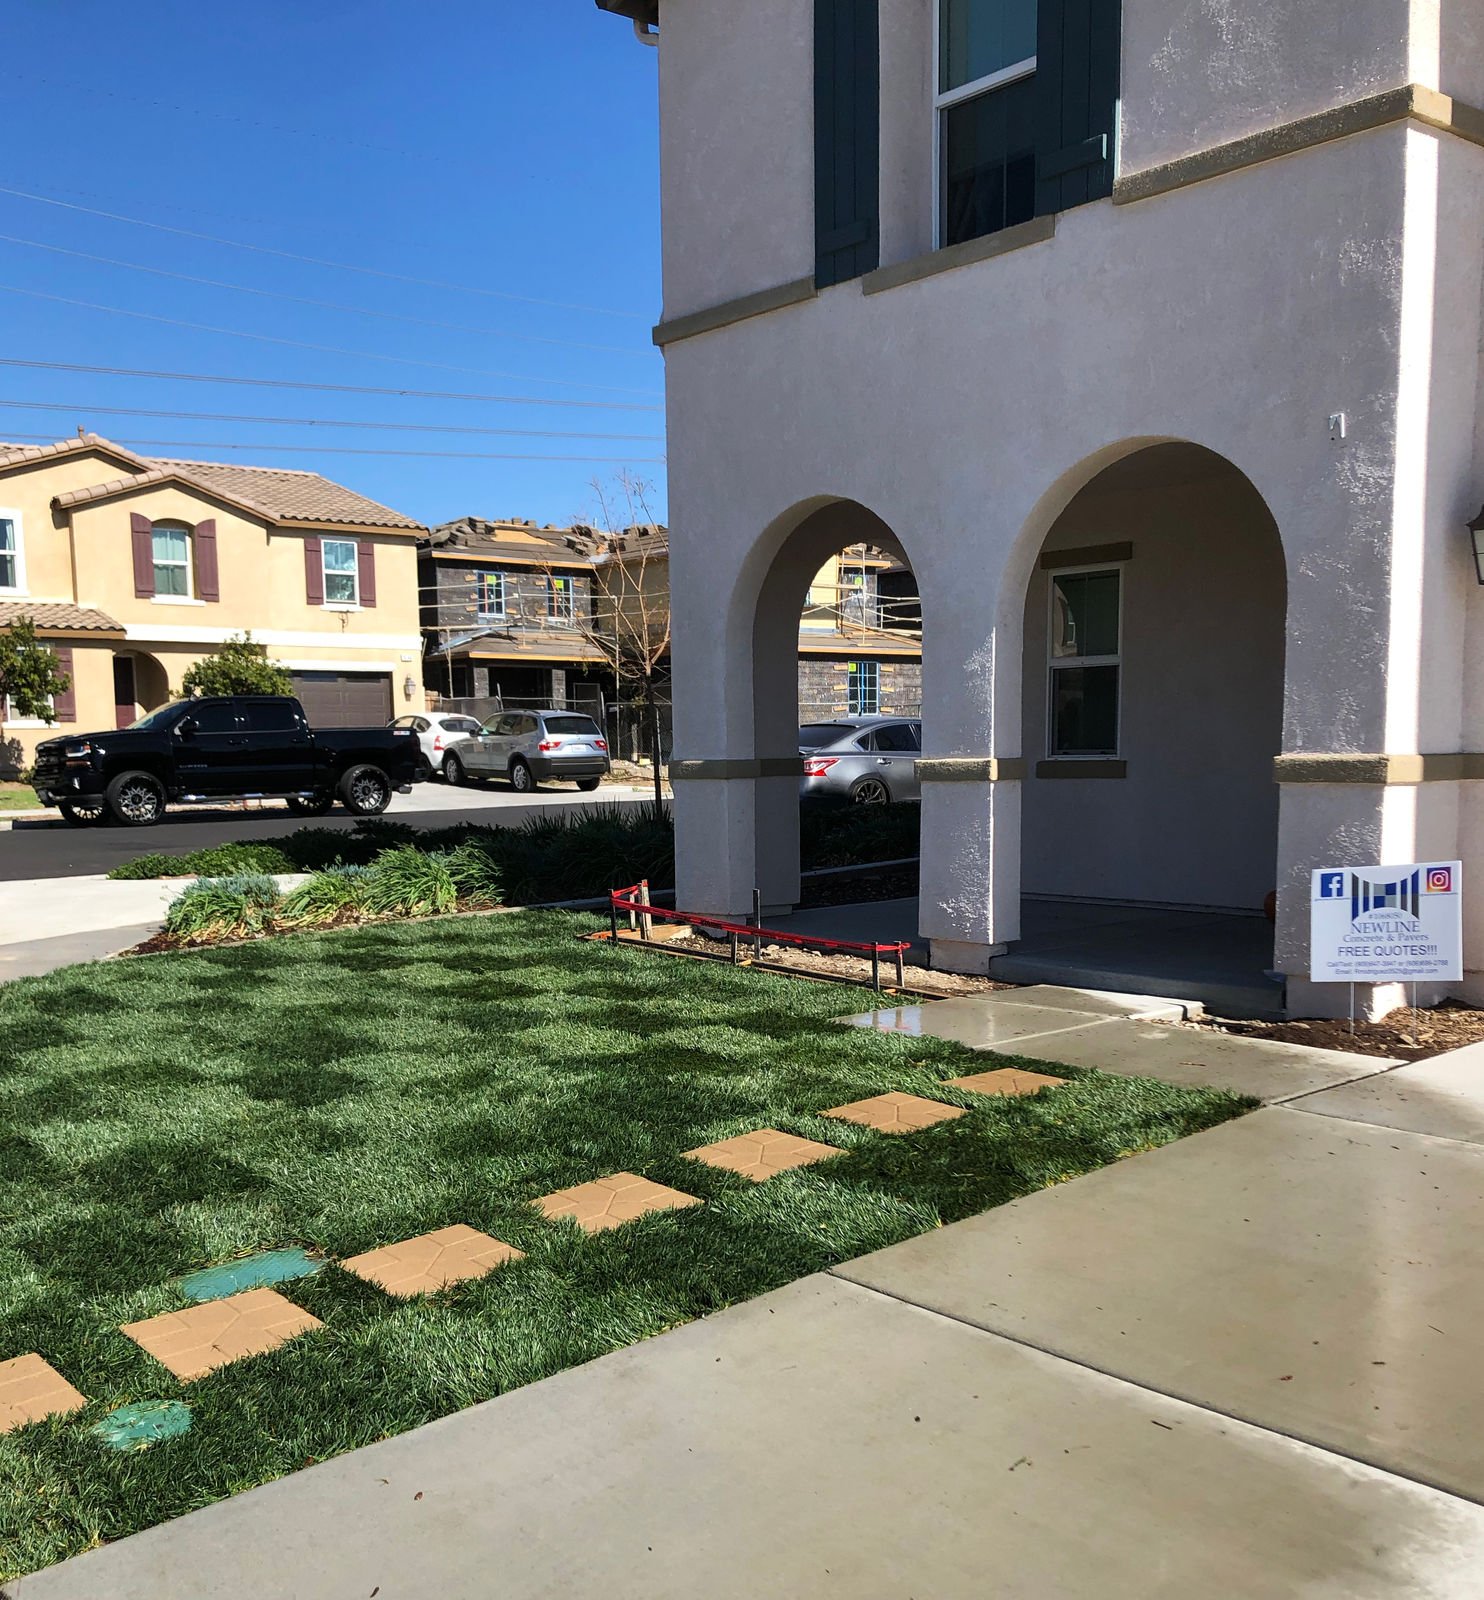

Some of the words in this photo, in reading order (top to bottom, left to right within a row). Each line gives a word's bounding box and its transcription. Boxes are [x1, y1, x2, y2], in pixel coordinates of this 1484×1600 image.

[1351, 921, 1421, 934] NEWLINE
[1343, 934, 1383, 943] Concrete
[1387, 934, 1395, 942] &
[1398, 933, 1429, 942] Pavers
[1337, 946, 1370, 957] FREE
[1374, 945, 1438, 957] QUOTES!!!
